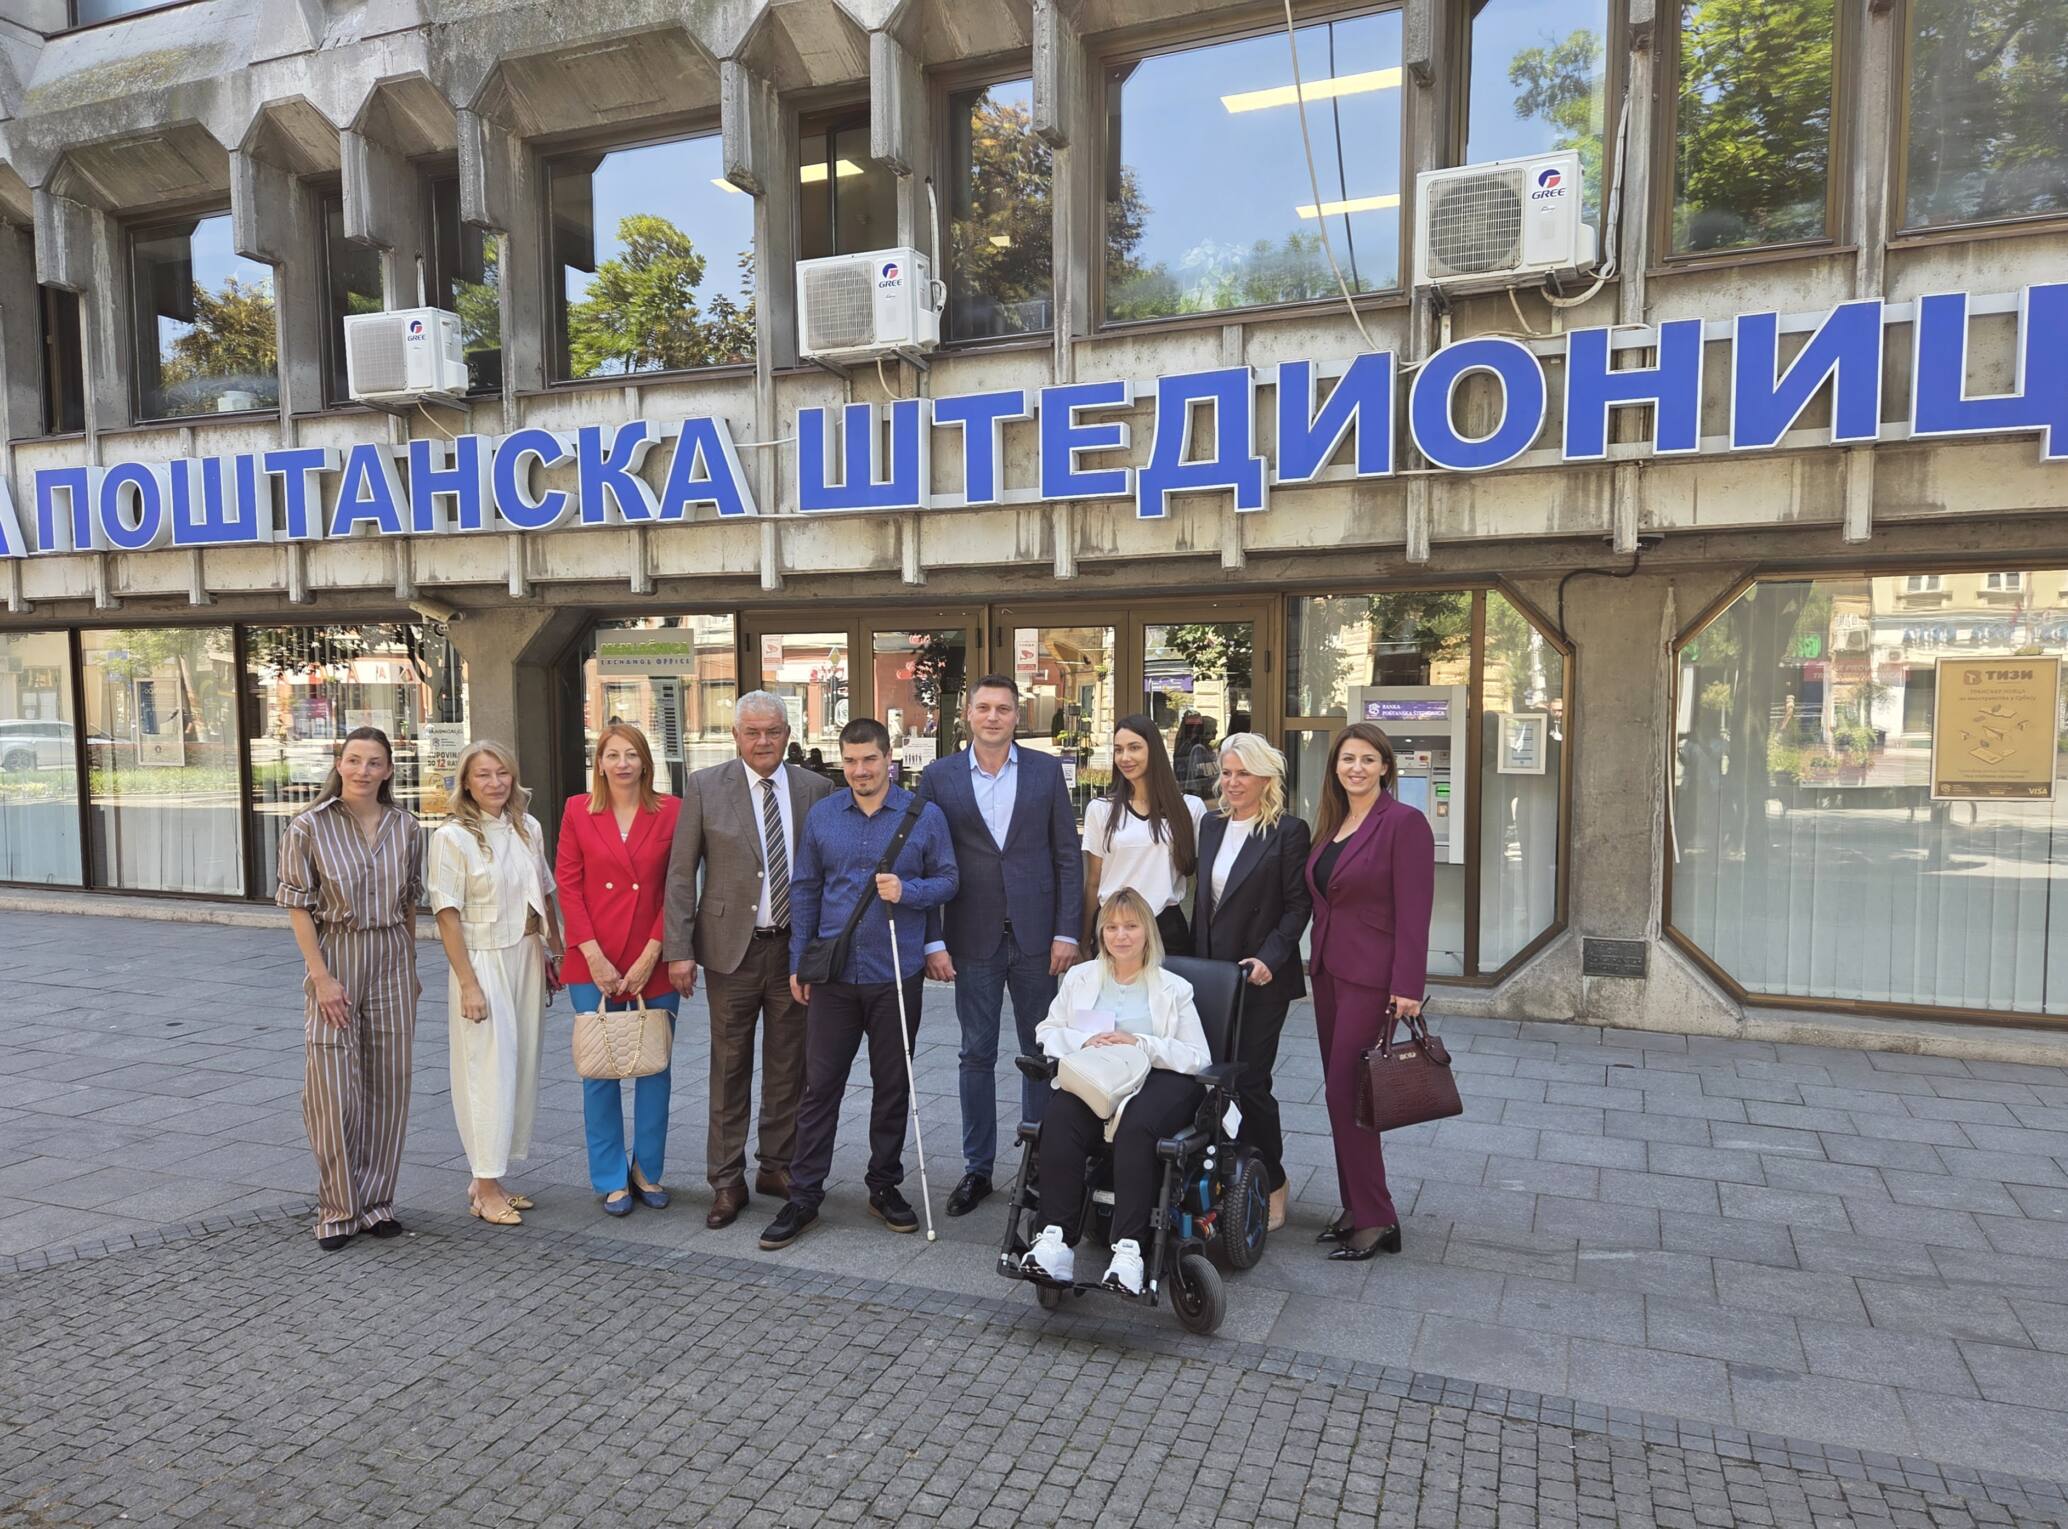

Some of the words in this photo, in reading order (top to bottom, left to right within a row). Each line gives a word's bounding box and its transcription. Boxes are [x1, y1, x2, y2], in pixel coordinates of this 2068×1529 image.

[1531, 187, 1566, 200] GREE
[878, 279, 903, 289] GREE
[407, 334, 425, 342] GREE
[34, 415, 759, 554] ПОШТАНСКА
[655, 658, 690, 666] OFFICE
[1984, 669, 2034, 681] ТИЗИ
[436, 758, 446, 768] 12
[2028, 787, 2049, 796] VISA
